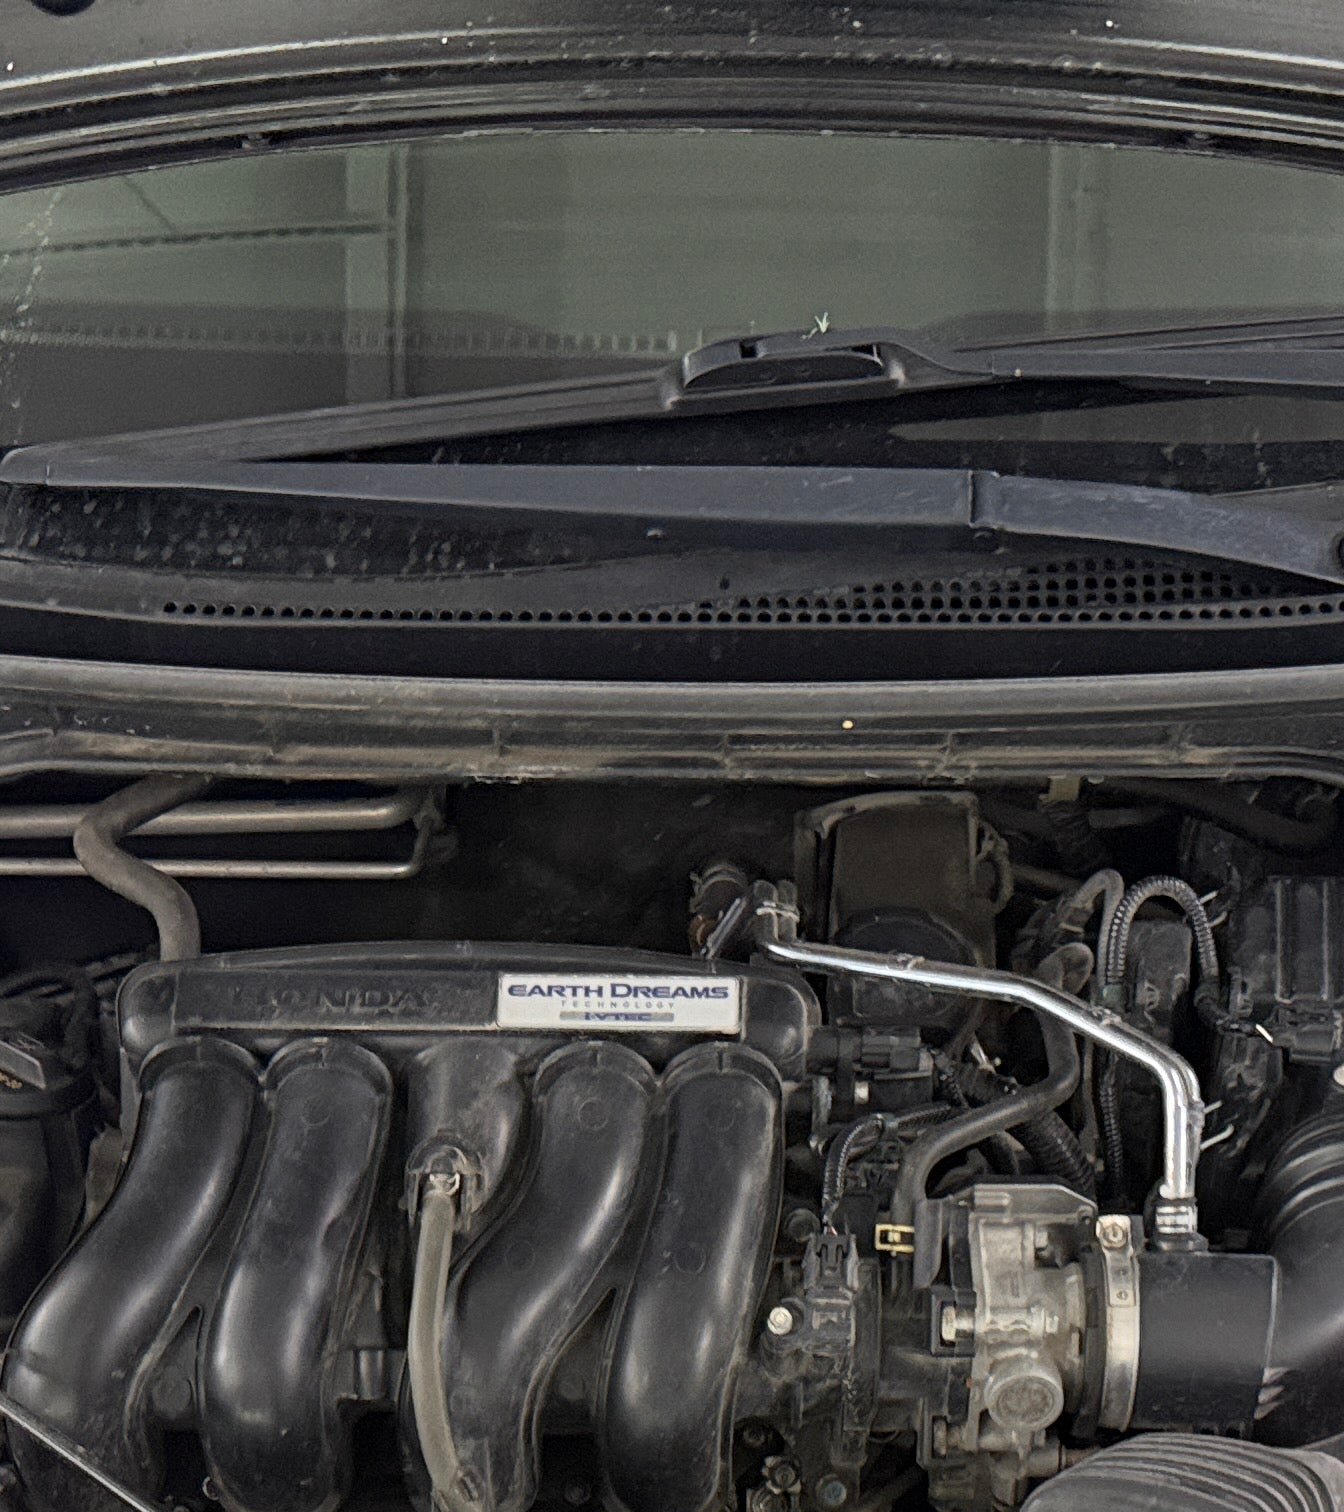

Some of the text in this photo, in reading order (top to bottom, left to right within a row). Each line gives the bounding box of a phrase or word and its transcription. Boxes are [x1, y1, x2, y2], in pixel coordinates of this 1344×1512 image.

[508, 983, 729, 999] EARTH DREAMS
[561, 1000, 674, 1009] TECHNOLOGY
